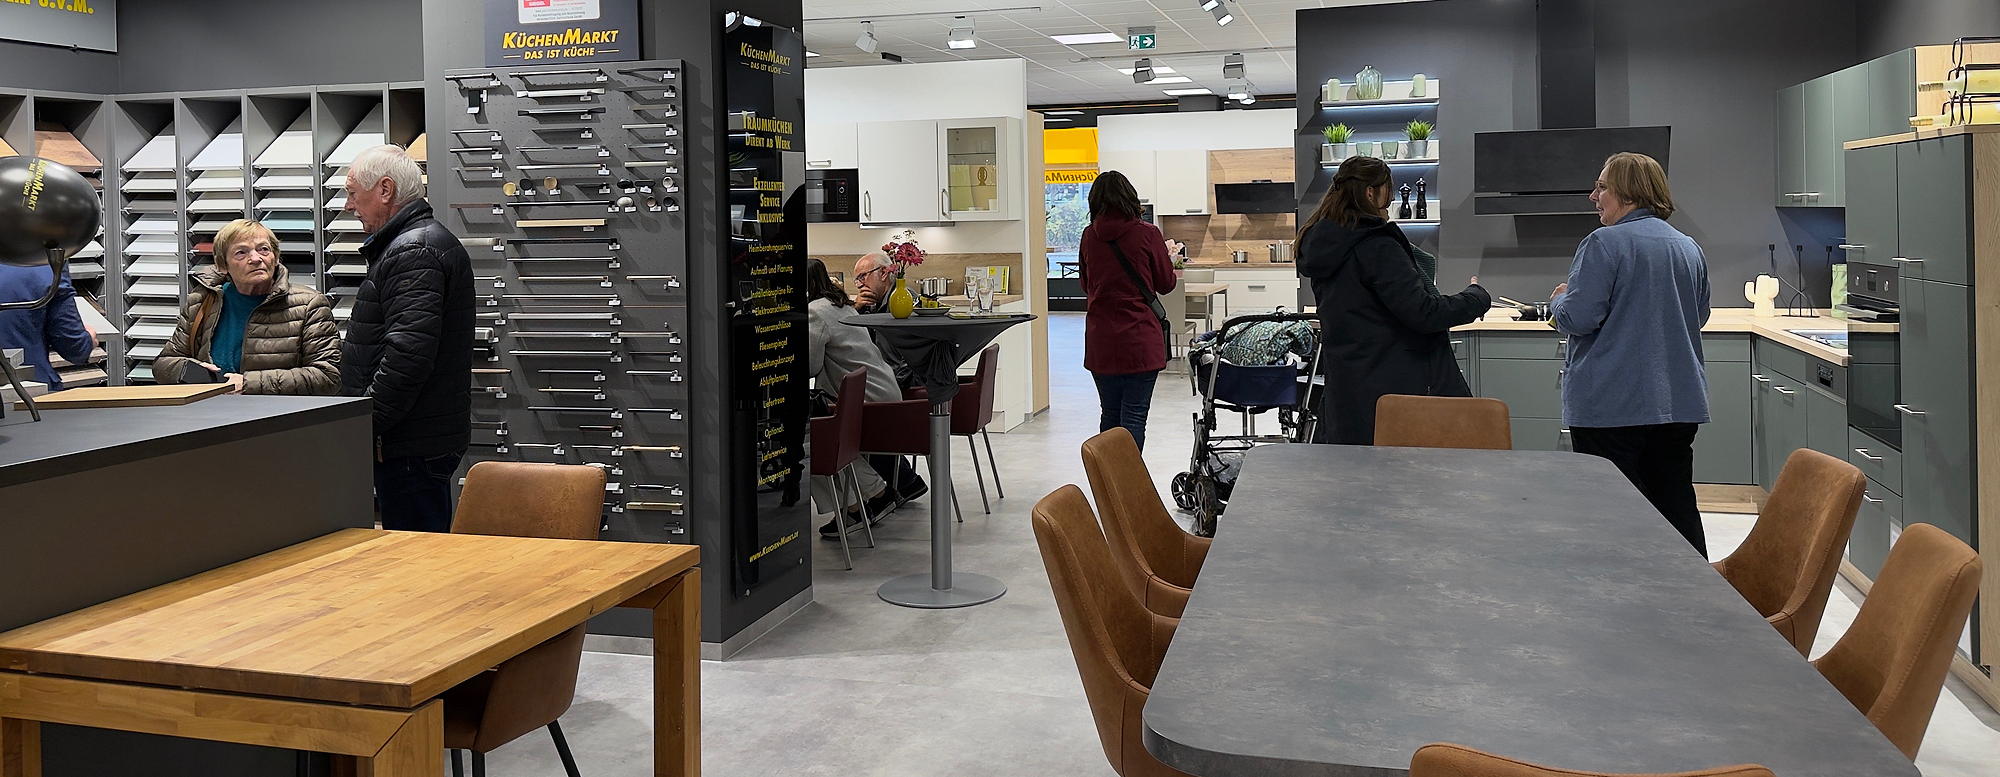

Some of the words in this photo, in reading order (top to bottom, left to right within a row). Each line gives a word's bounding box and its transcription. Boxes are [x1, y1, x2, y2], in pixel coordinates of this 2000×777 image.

[502, 27, 619, 49] KÜCHENMARKT
[524, 50, 543, 60] DAS
[546, 49, 561, 59] IST
[563, 46, 595, 58] KÜCHE
[740, 42, 791, 67] KÜCHENMARKT
[750, 61, 760, 71] DAS
[767, 64, 782, 75] KÜCHE
[742, 111, 793, 135] TRAUMKÜCHEN
[745, 132, 765, 147] DIREKT
[766, 137, 774, 148] AB
[775, 135, 791, 150] WERK
[760, 193, 780, 207] SERVICE
[757, 209, 784, 223] INKLUSIVE!
[768, 264, 776, 274] und
[777, 264, 793, 274] Planung
[755, 320, 791, 333] Wasseranschlüsse
[760, 337, 788, 351] Fliesenspiegel
[752, 353, 794, 371] Beleuchtungskonzept
[760, 374, 788, 387] Abluftplanung
[763, 397, 785, 409] Liefertreue
[762, 446, 787, 462] Lieferservice
[758, 467, 791, 486] Montageservice
